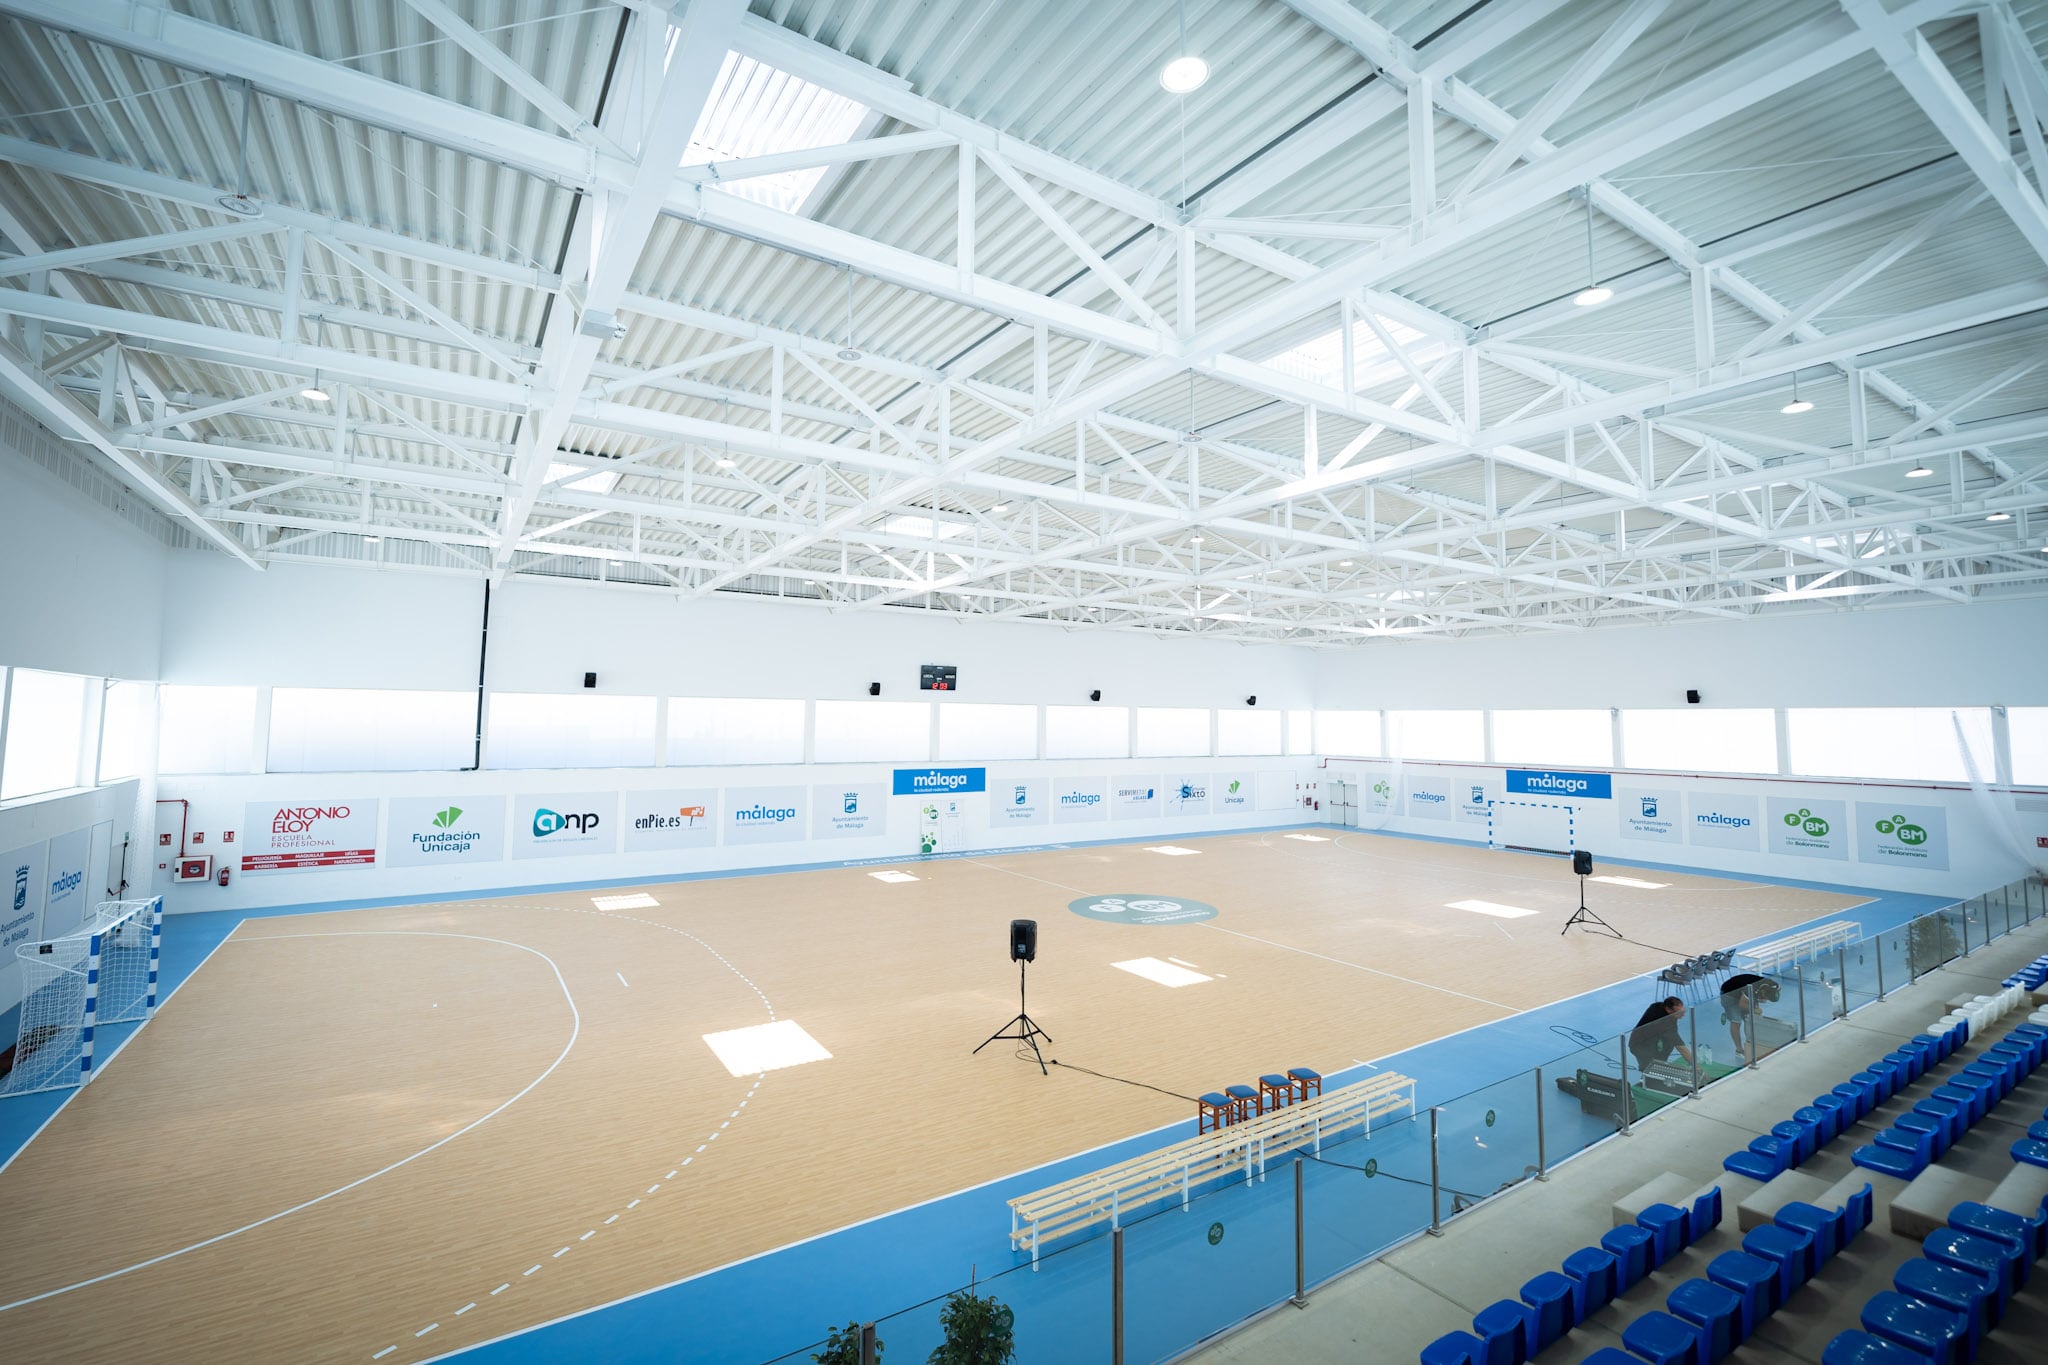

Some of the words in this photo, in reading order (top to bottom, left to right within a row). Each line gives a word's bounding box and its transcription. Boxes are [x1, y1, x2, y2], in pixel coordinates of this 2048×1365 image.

[274, 806, 350, 820] ANTONIO
[272, 820, 313, 833] ELOY
[635, 815, 680, 829] enPie.es
[1629, 818, 1672, 827] Ayuntamiento
[1805, 822, 1826, 832] BM
[1882, 823, 1888, 831] F
[413, 831, 480, 842] Fundación
[1900, 829, 1924, 840] BM
[272, 840, 336, 848] PROFESIONAL
[422, 841, 470, 853] Unicaja
[1888, 850, 1927, 858] Balonmano
[0, 912, 34, 933] Ayuntamiento
